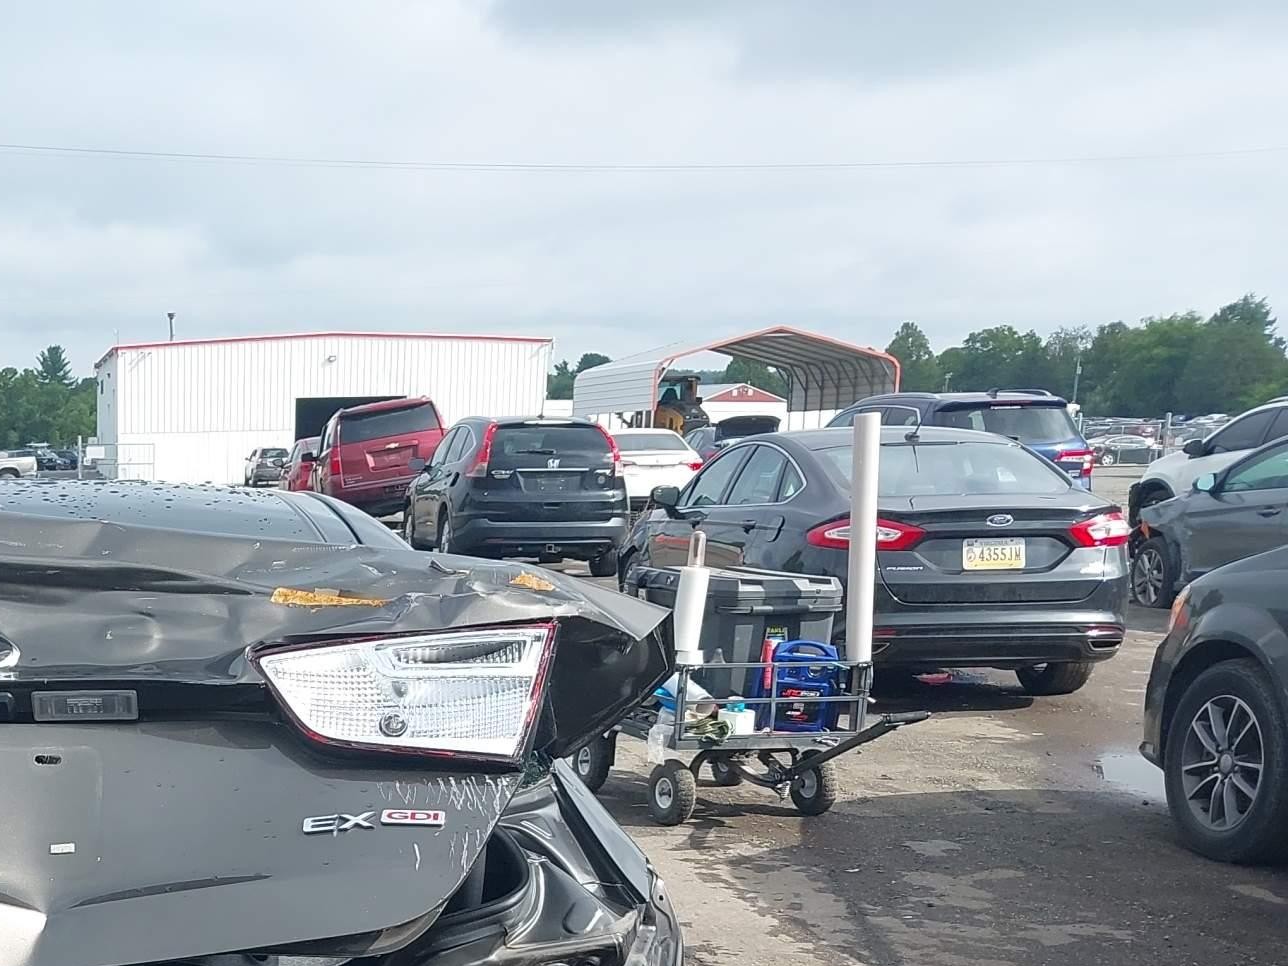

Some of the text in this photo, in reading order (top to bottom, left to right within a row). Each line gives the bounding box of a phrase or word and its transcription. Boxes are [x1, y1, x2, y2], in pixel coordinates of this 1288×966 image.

[978, 547, 1021, 562] 4355JM
[302, 810, 439, 833] EX GDI
